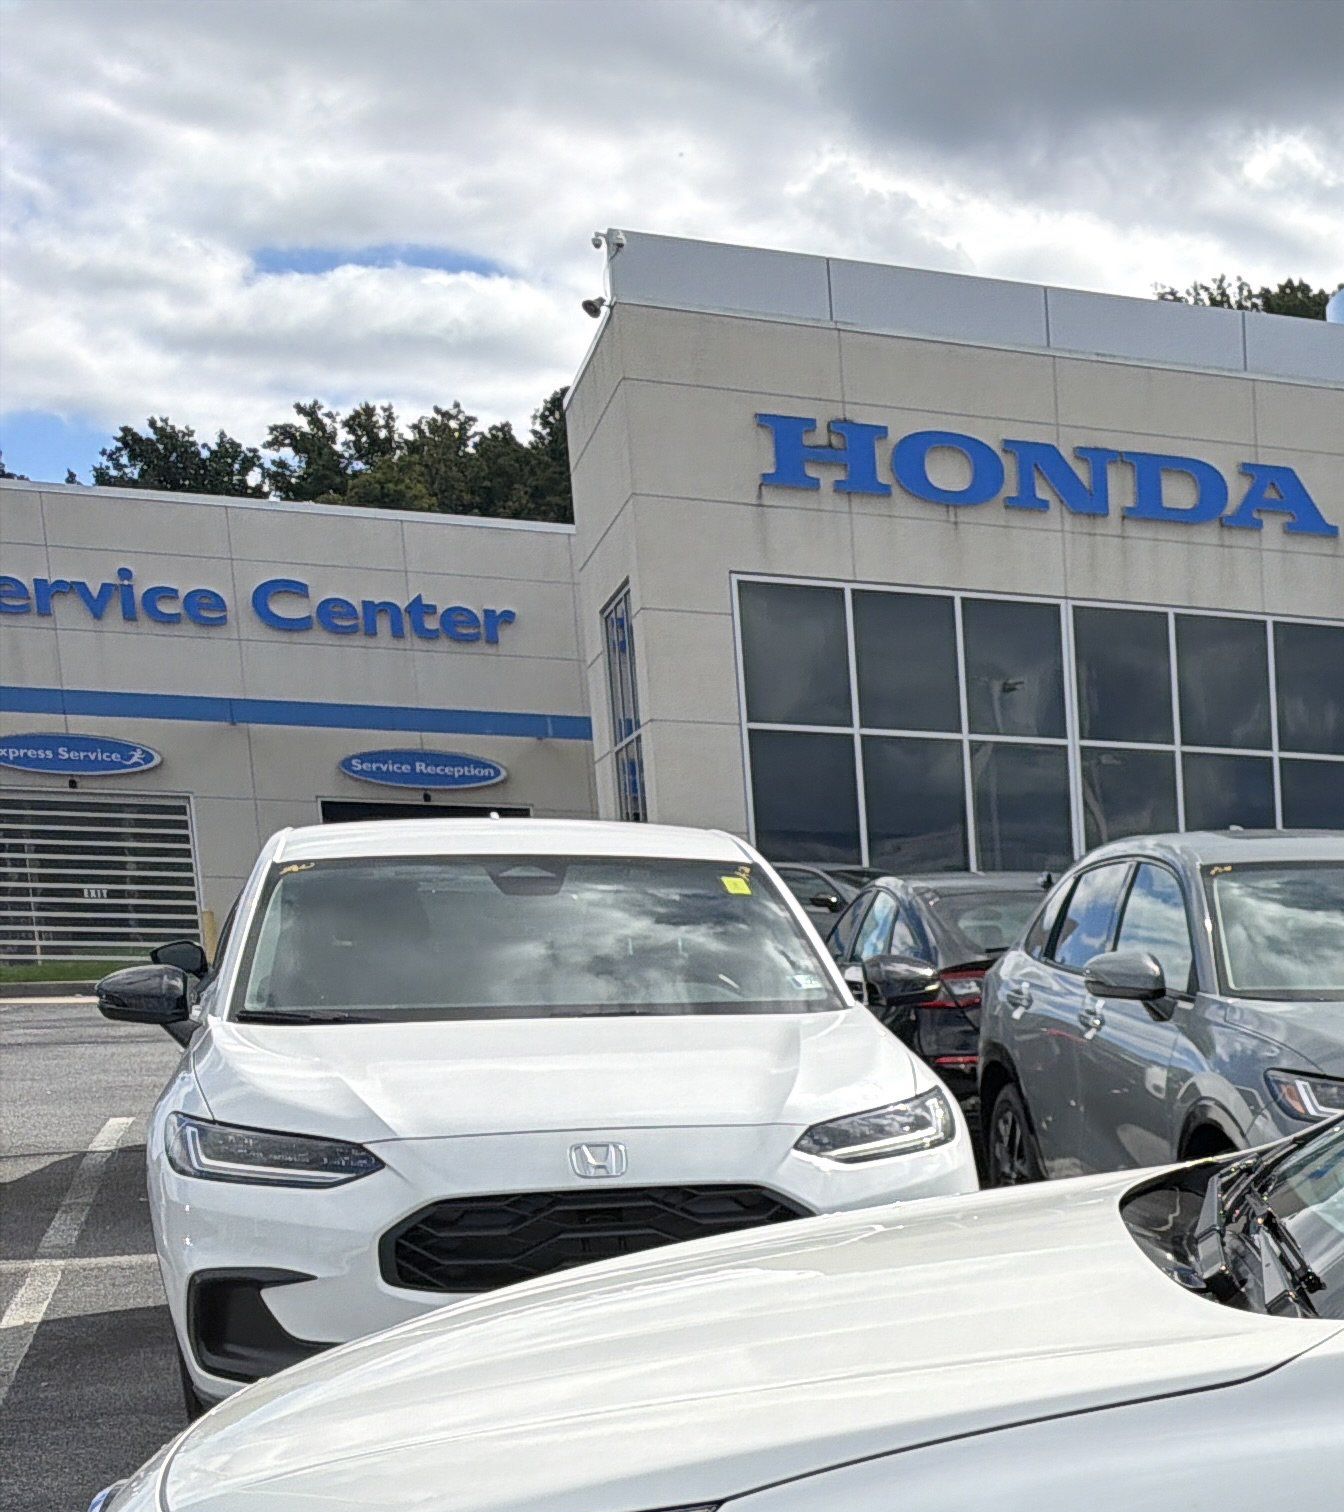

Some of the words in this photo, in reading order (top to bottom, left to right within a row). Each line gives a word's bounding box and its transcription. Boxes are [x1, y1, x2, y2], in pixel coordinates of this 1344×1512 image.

[754, 412, 1339, 538] HONDA
[0, 567, 227, 626] ervice
[252, 577, 515, 644] Center
[58, 747, 121, 762] Service
[351, 758, 411, 773] Service
[415, 761, 495, 778] Reception
[83, 888, 108, 898] EXIT
